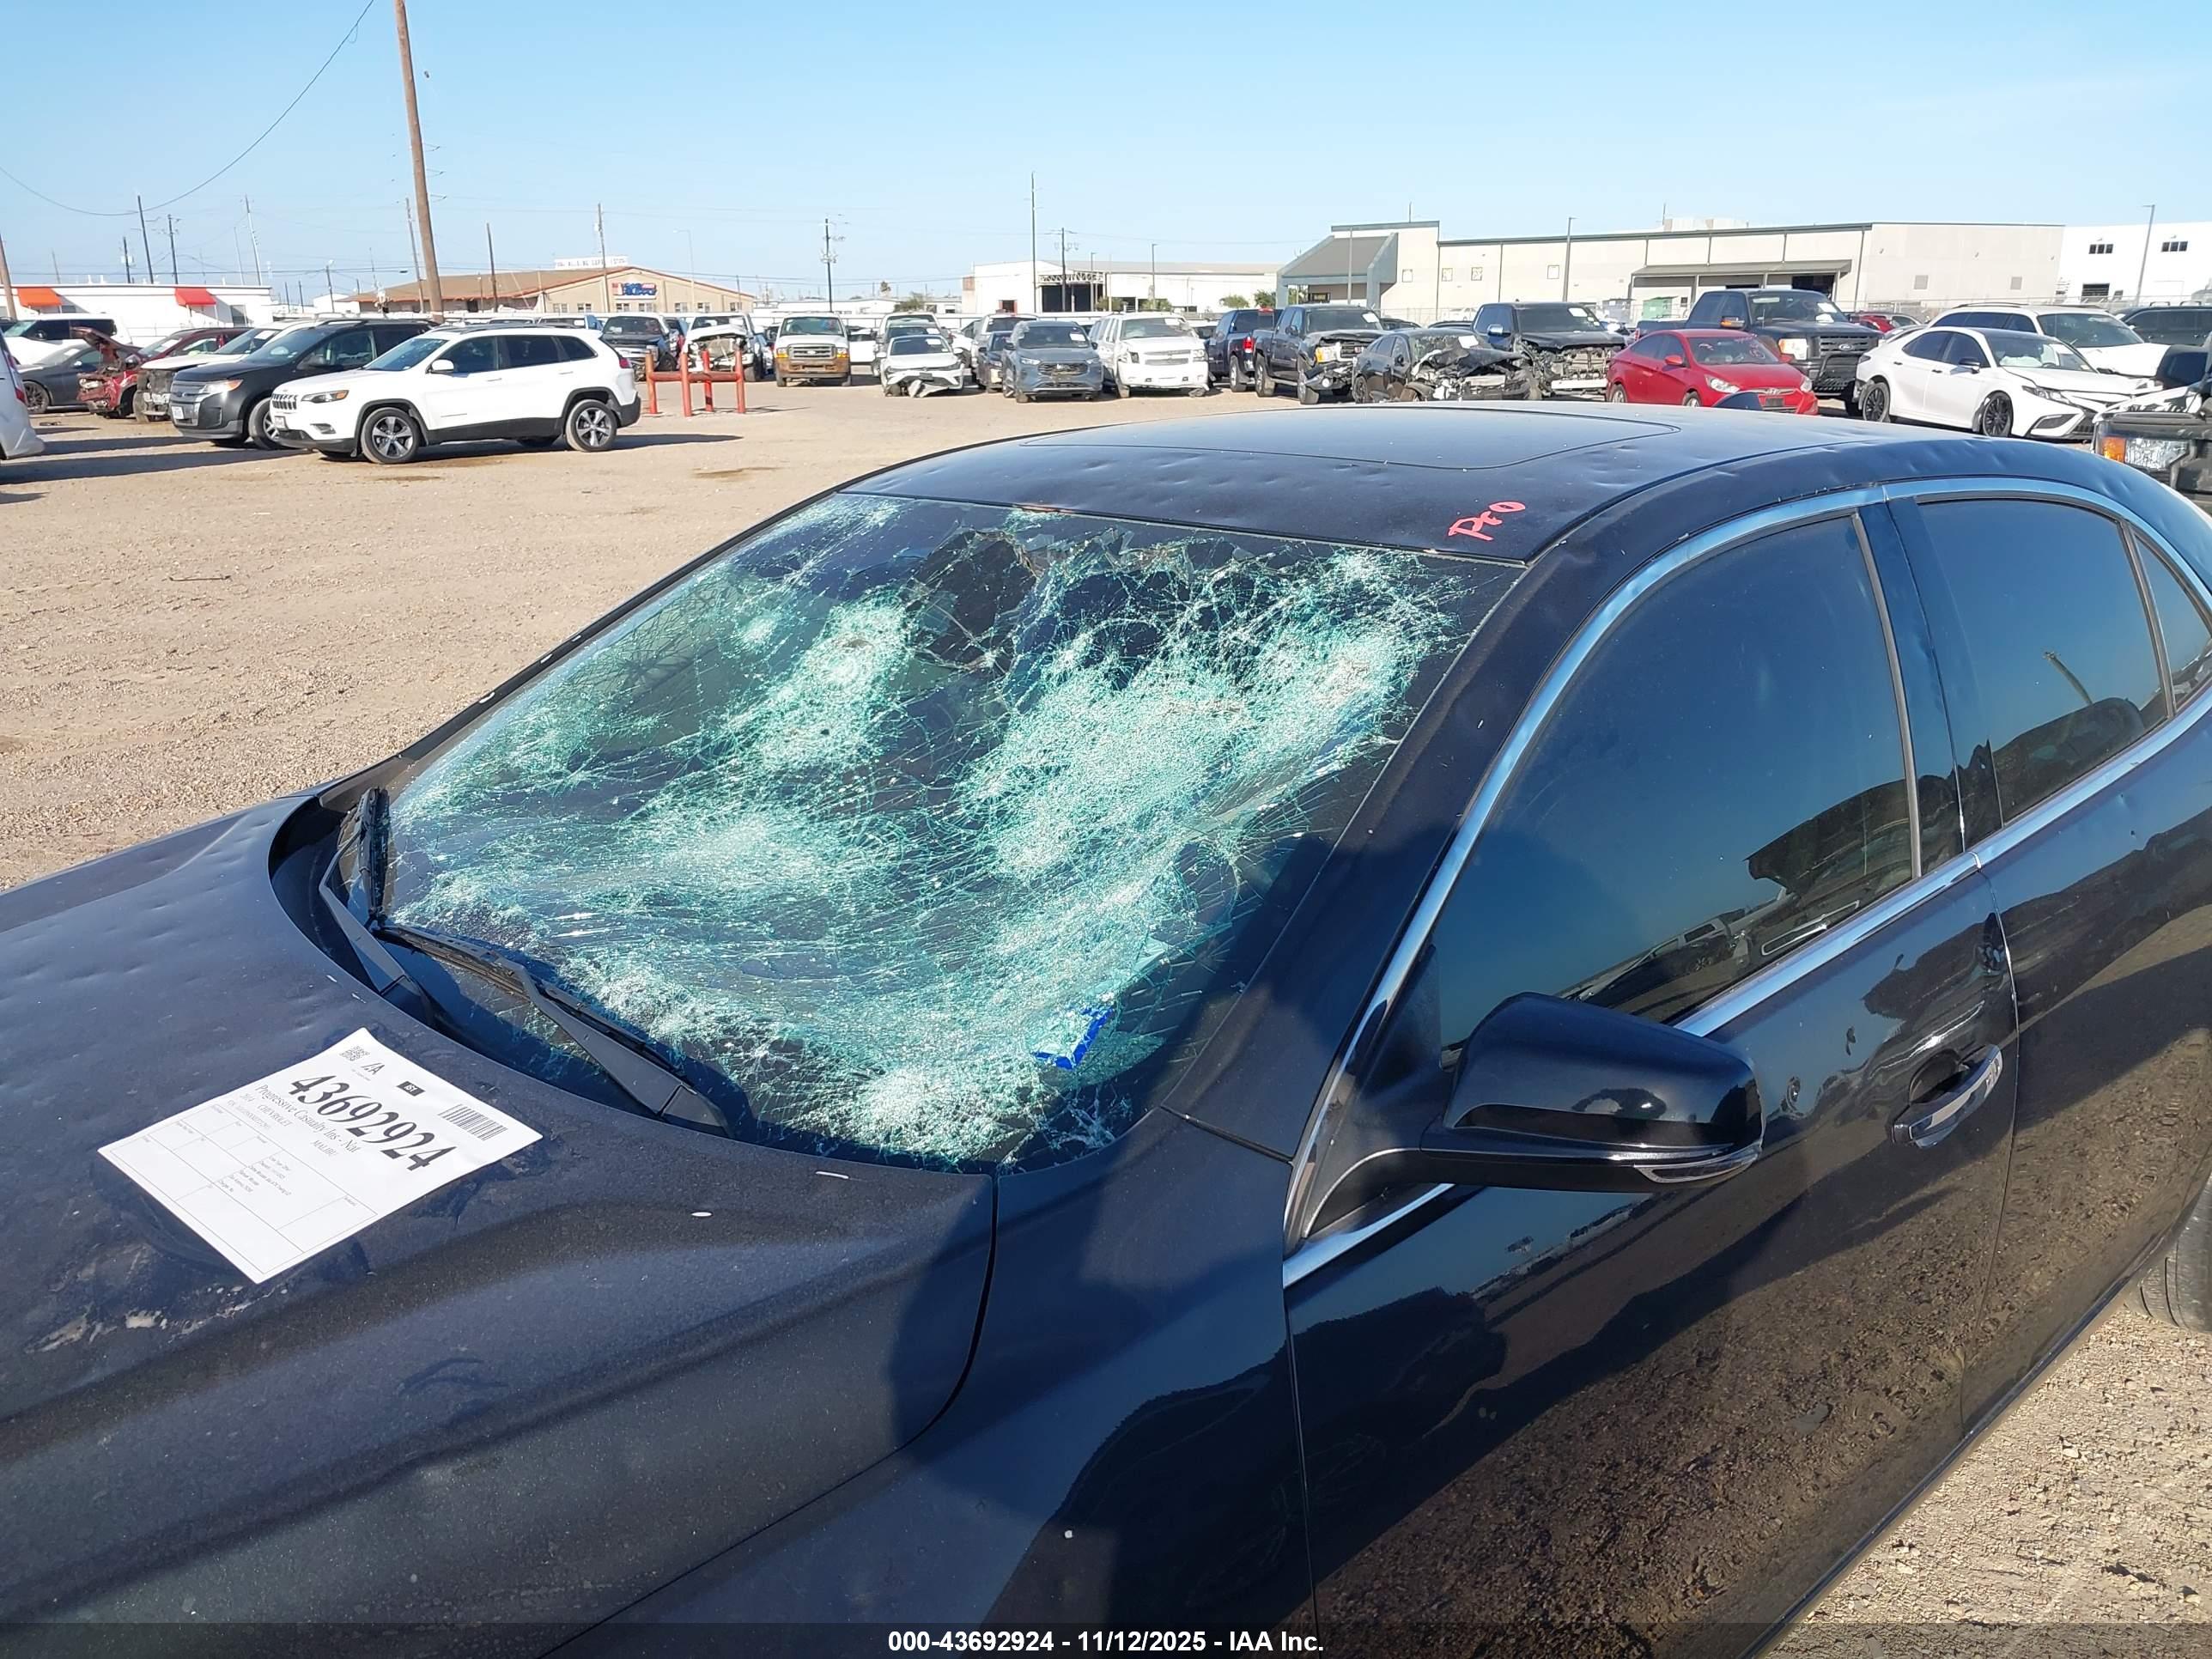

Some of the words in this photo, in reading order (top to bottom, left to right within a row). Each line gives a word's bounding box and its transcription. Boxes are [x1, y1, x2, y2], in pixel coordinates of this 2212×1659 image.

[255, 1085, 297, 1112] Progressive
[295, 1110, 326, 1133] Casualty
[324, 1128, 340, 1140] Ins
[289, 1075, 457, 1171] 43692924
